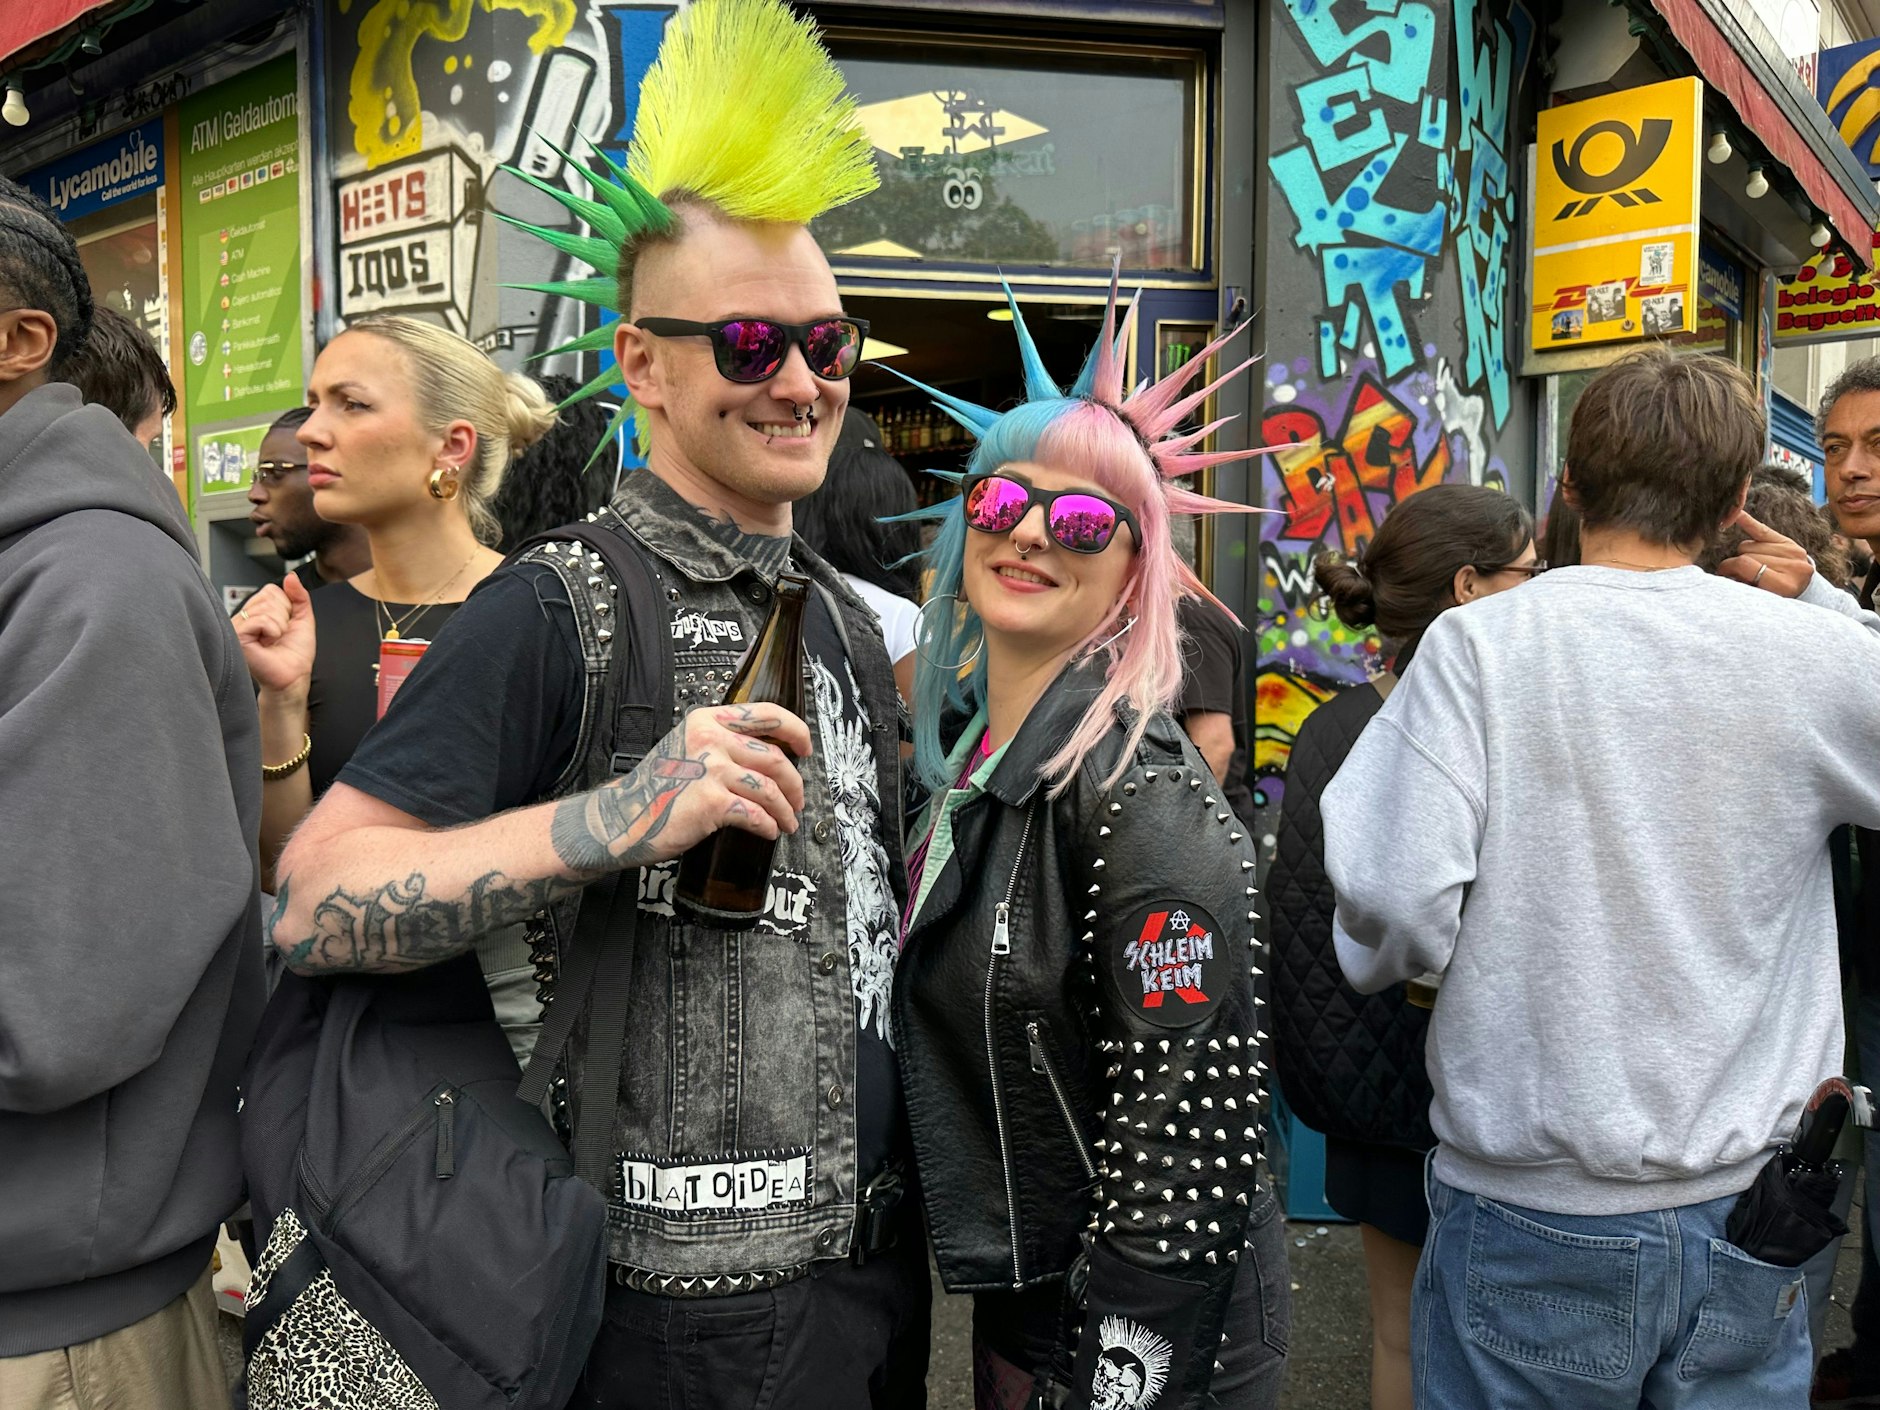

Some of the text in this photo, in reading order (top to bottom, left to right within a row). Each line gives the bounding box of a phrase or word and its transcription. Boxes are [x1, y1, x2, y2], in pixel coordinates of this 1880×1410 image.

[191, 116, 219, 154] ATM
[51, 138, 158, 211] Lycamobile
[101, 188, 112, 202] Call
[121, 179, 138, 195] world
[145, 174, 158, 185] less
[342, 170, 427, 233] HEETS
[347, 241, 430, 298] IQOS
[1700, 261, 1740, 304] camobile
[1552, 277, 1665, 310] DL
[1778, 283, 1875, 308] belegte
[1122, 932, 1214, 971] SCHLEIM
[1141, 962, 1203, 994] KEIM
